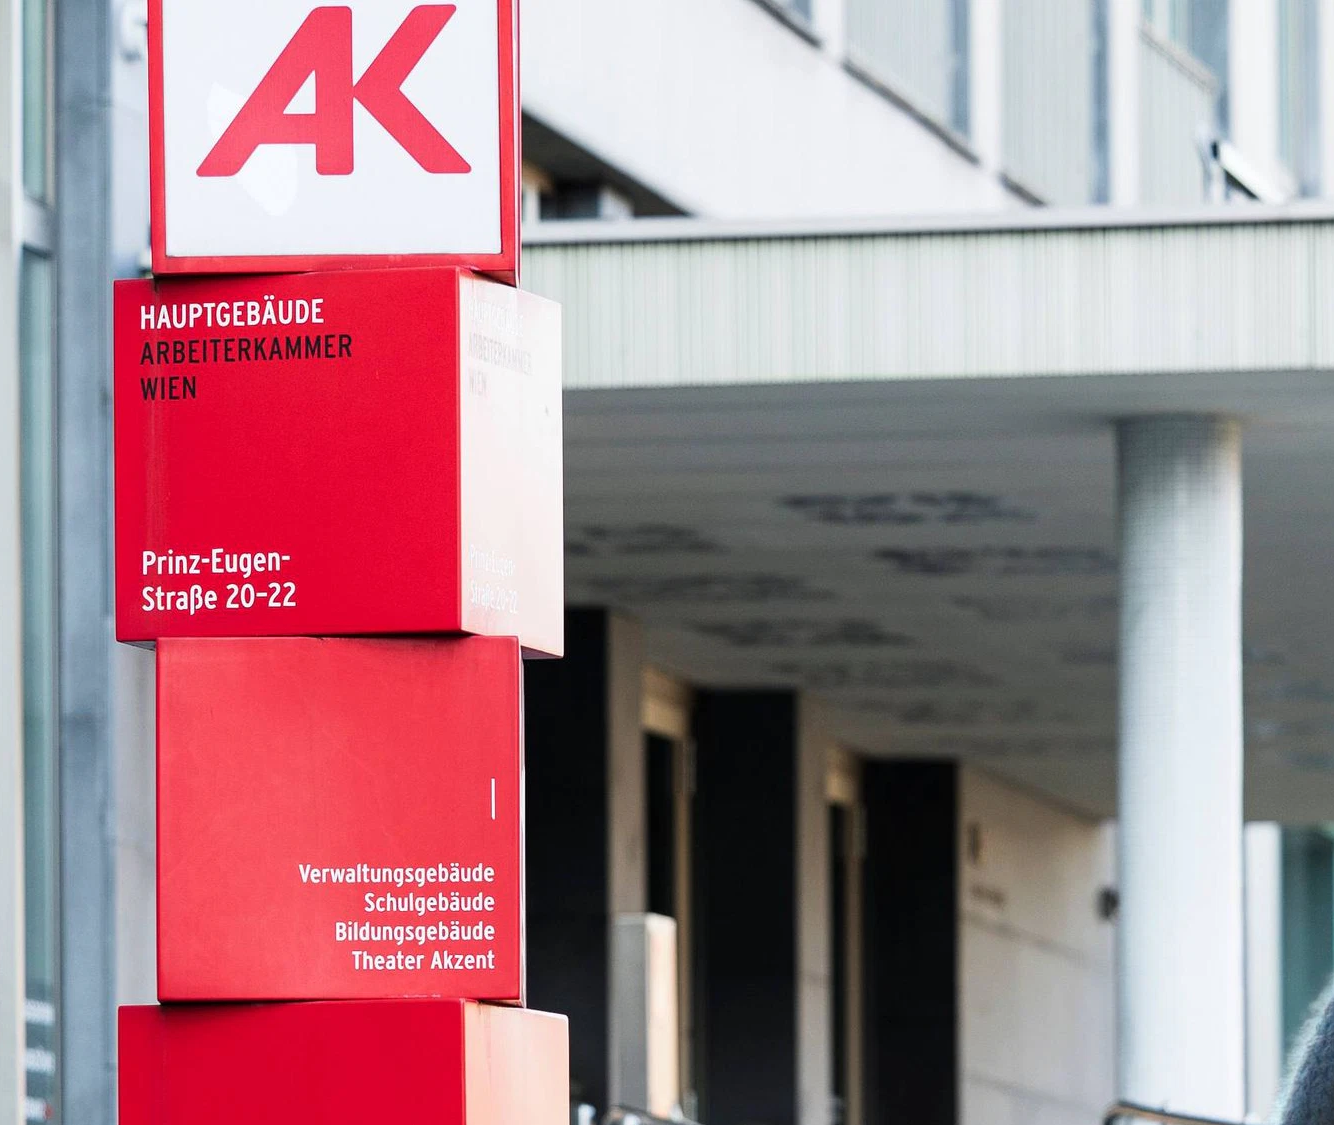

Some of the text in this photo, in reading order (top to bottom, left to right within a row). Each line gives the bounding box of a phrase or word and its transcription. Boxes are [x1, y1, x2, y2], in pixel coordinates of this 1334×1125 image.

[196, 4, 472, 177] AK
[140, 294, 324, 330] HAUPTGEBÄUDE
[139, 334, 353, 366] ARBEITERKAMMER
[140, 375, 197, 401] WIEN
[142, 548, 291, 579] Prinz-Eugen-
[141, 584, 218, 616] Straße
[298, 862, 496, 888] Verwaltungsgebäude
[364, 891, 496, 917] Schulgebäude
[335, 920, 496, 946] Bildungsgebäude
[352, 950, 496, 970] Theater Akzent
